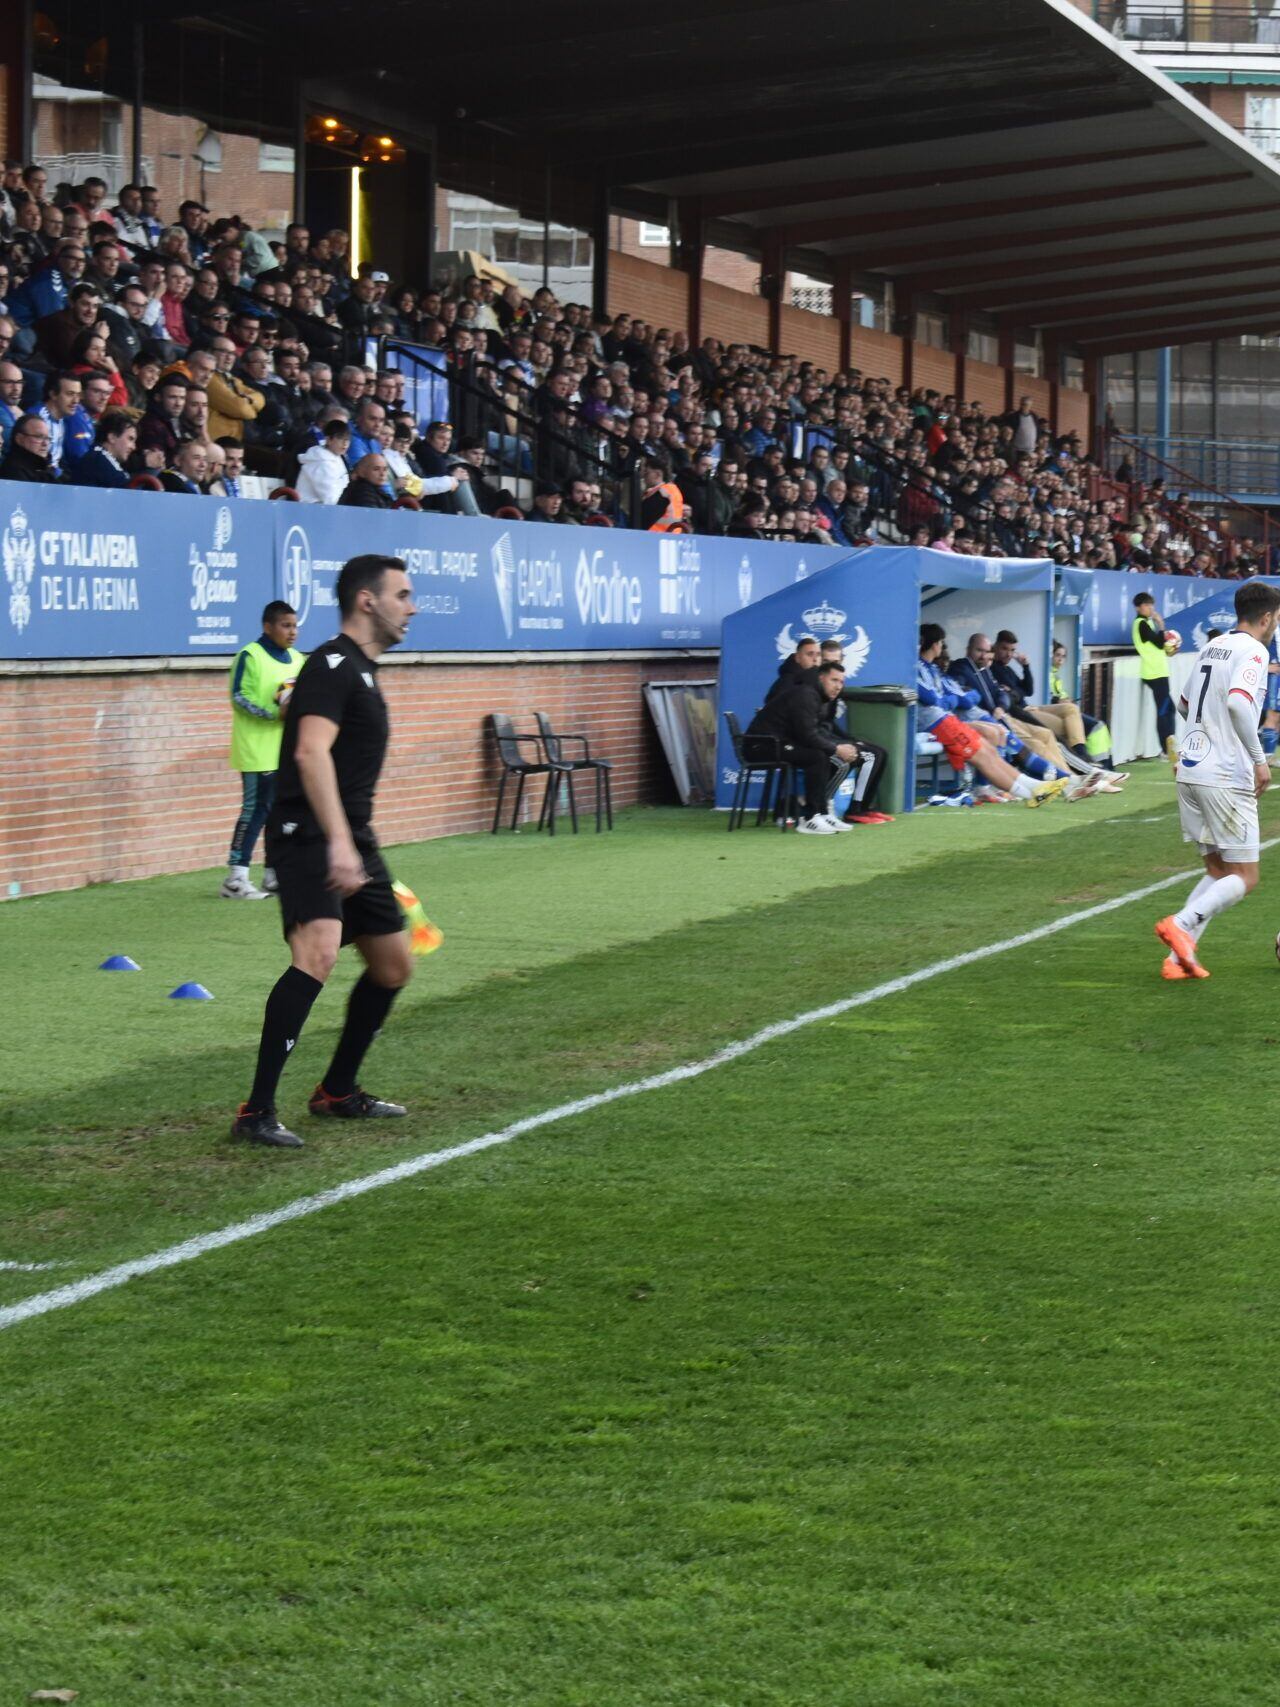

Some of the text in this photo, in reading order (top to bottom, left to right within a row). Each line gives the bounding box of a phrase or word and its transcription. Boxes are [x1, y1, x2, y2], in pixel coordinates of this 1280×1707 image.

[39, 531, 139, 568] CF TALAVERA
[440, 551, 479, 582] PARQUE
[41, 576, 139, 611] DE LA REINA
[517, 550, 564, 607] GARCÍA
[677, 576, 702, 616] PVC
[1195, 664, 1213, 723] 7
